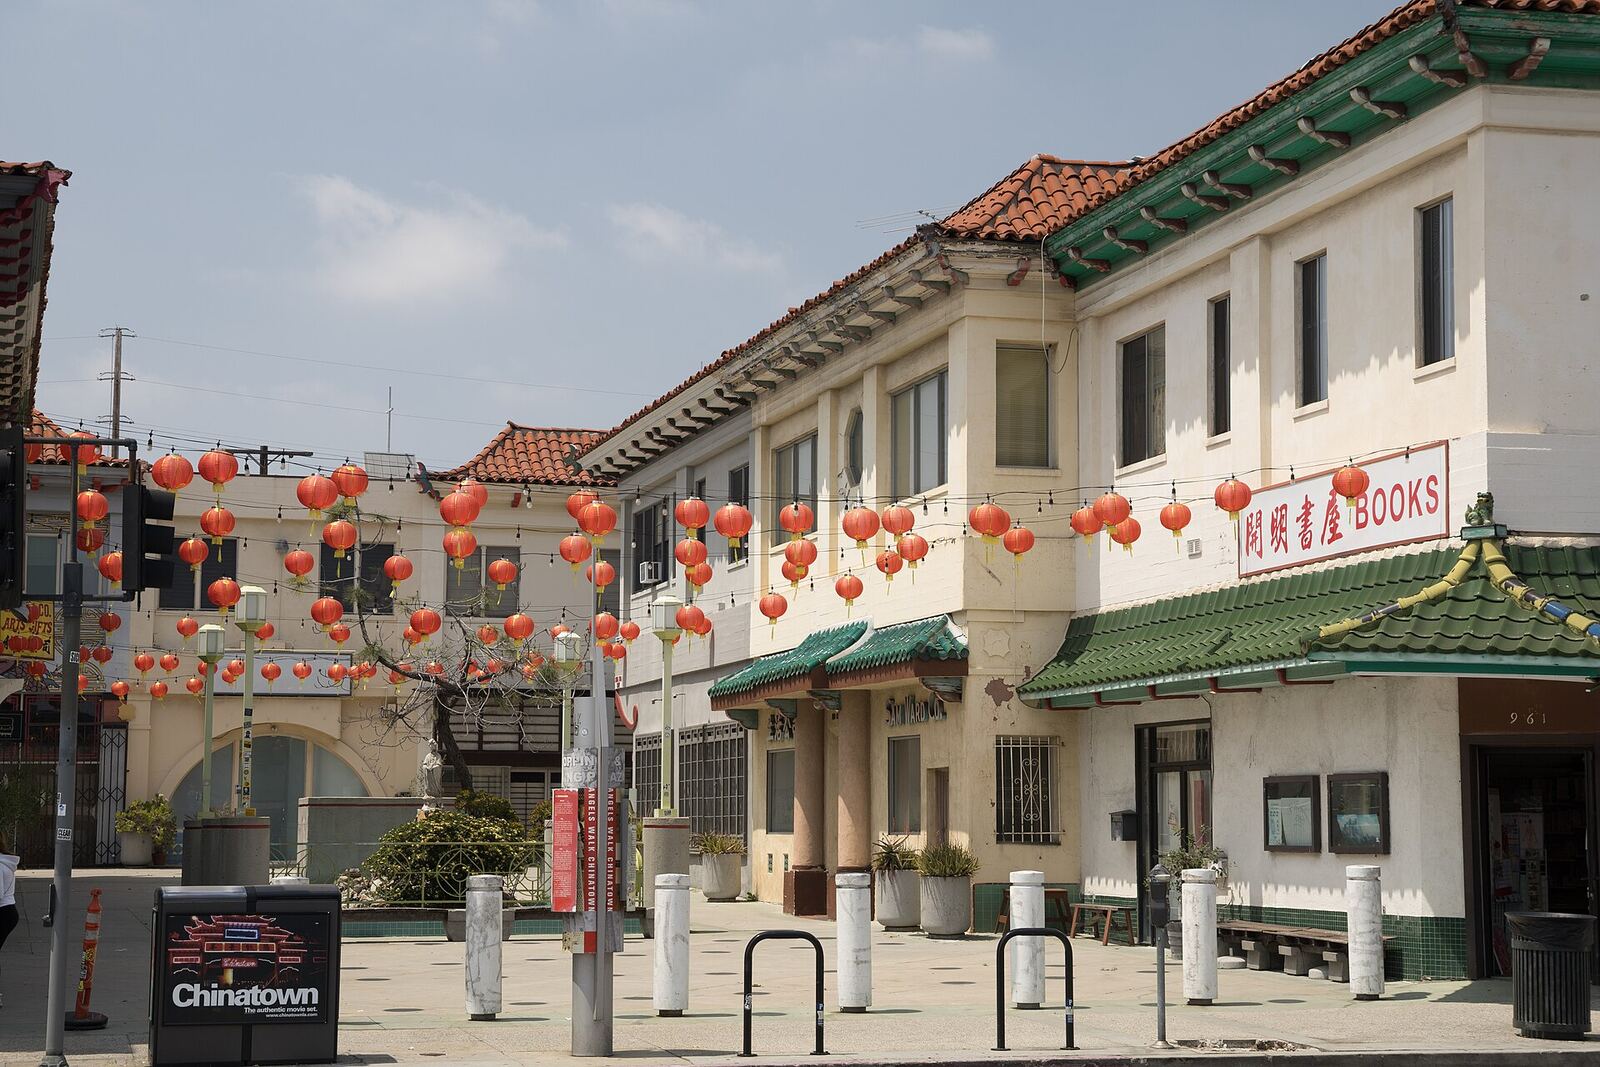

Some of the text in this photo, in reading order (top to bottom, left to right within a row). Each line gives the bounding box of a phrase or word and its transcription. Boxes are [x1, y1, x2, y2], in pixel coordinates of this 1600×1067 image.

[1355, 474, 1439, 530] BOOKS
[1509, 712, 1546, 725] 961
[588, 787, 596, 911] ANGELS WALK CHINATOWN
[172, 983, 319, 1007] Chinatown
